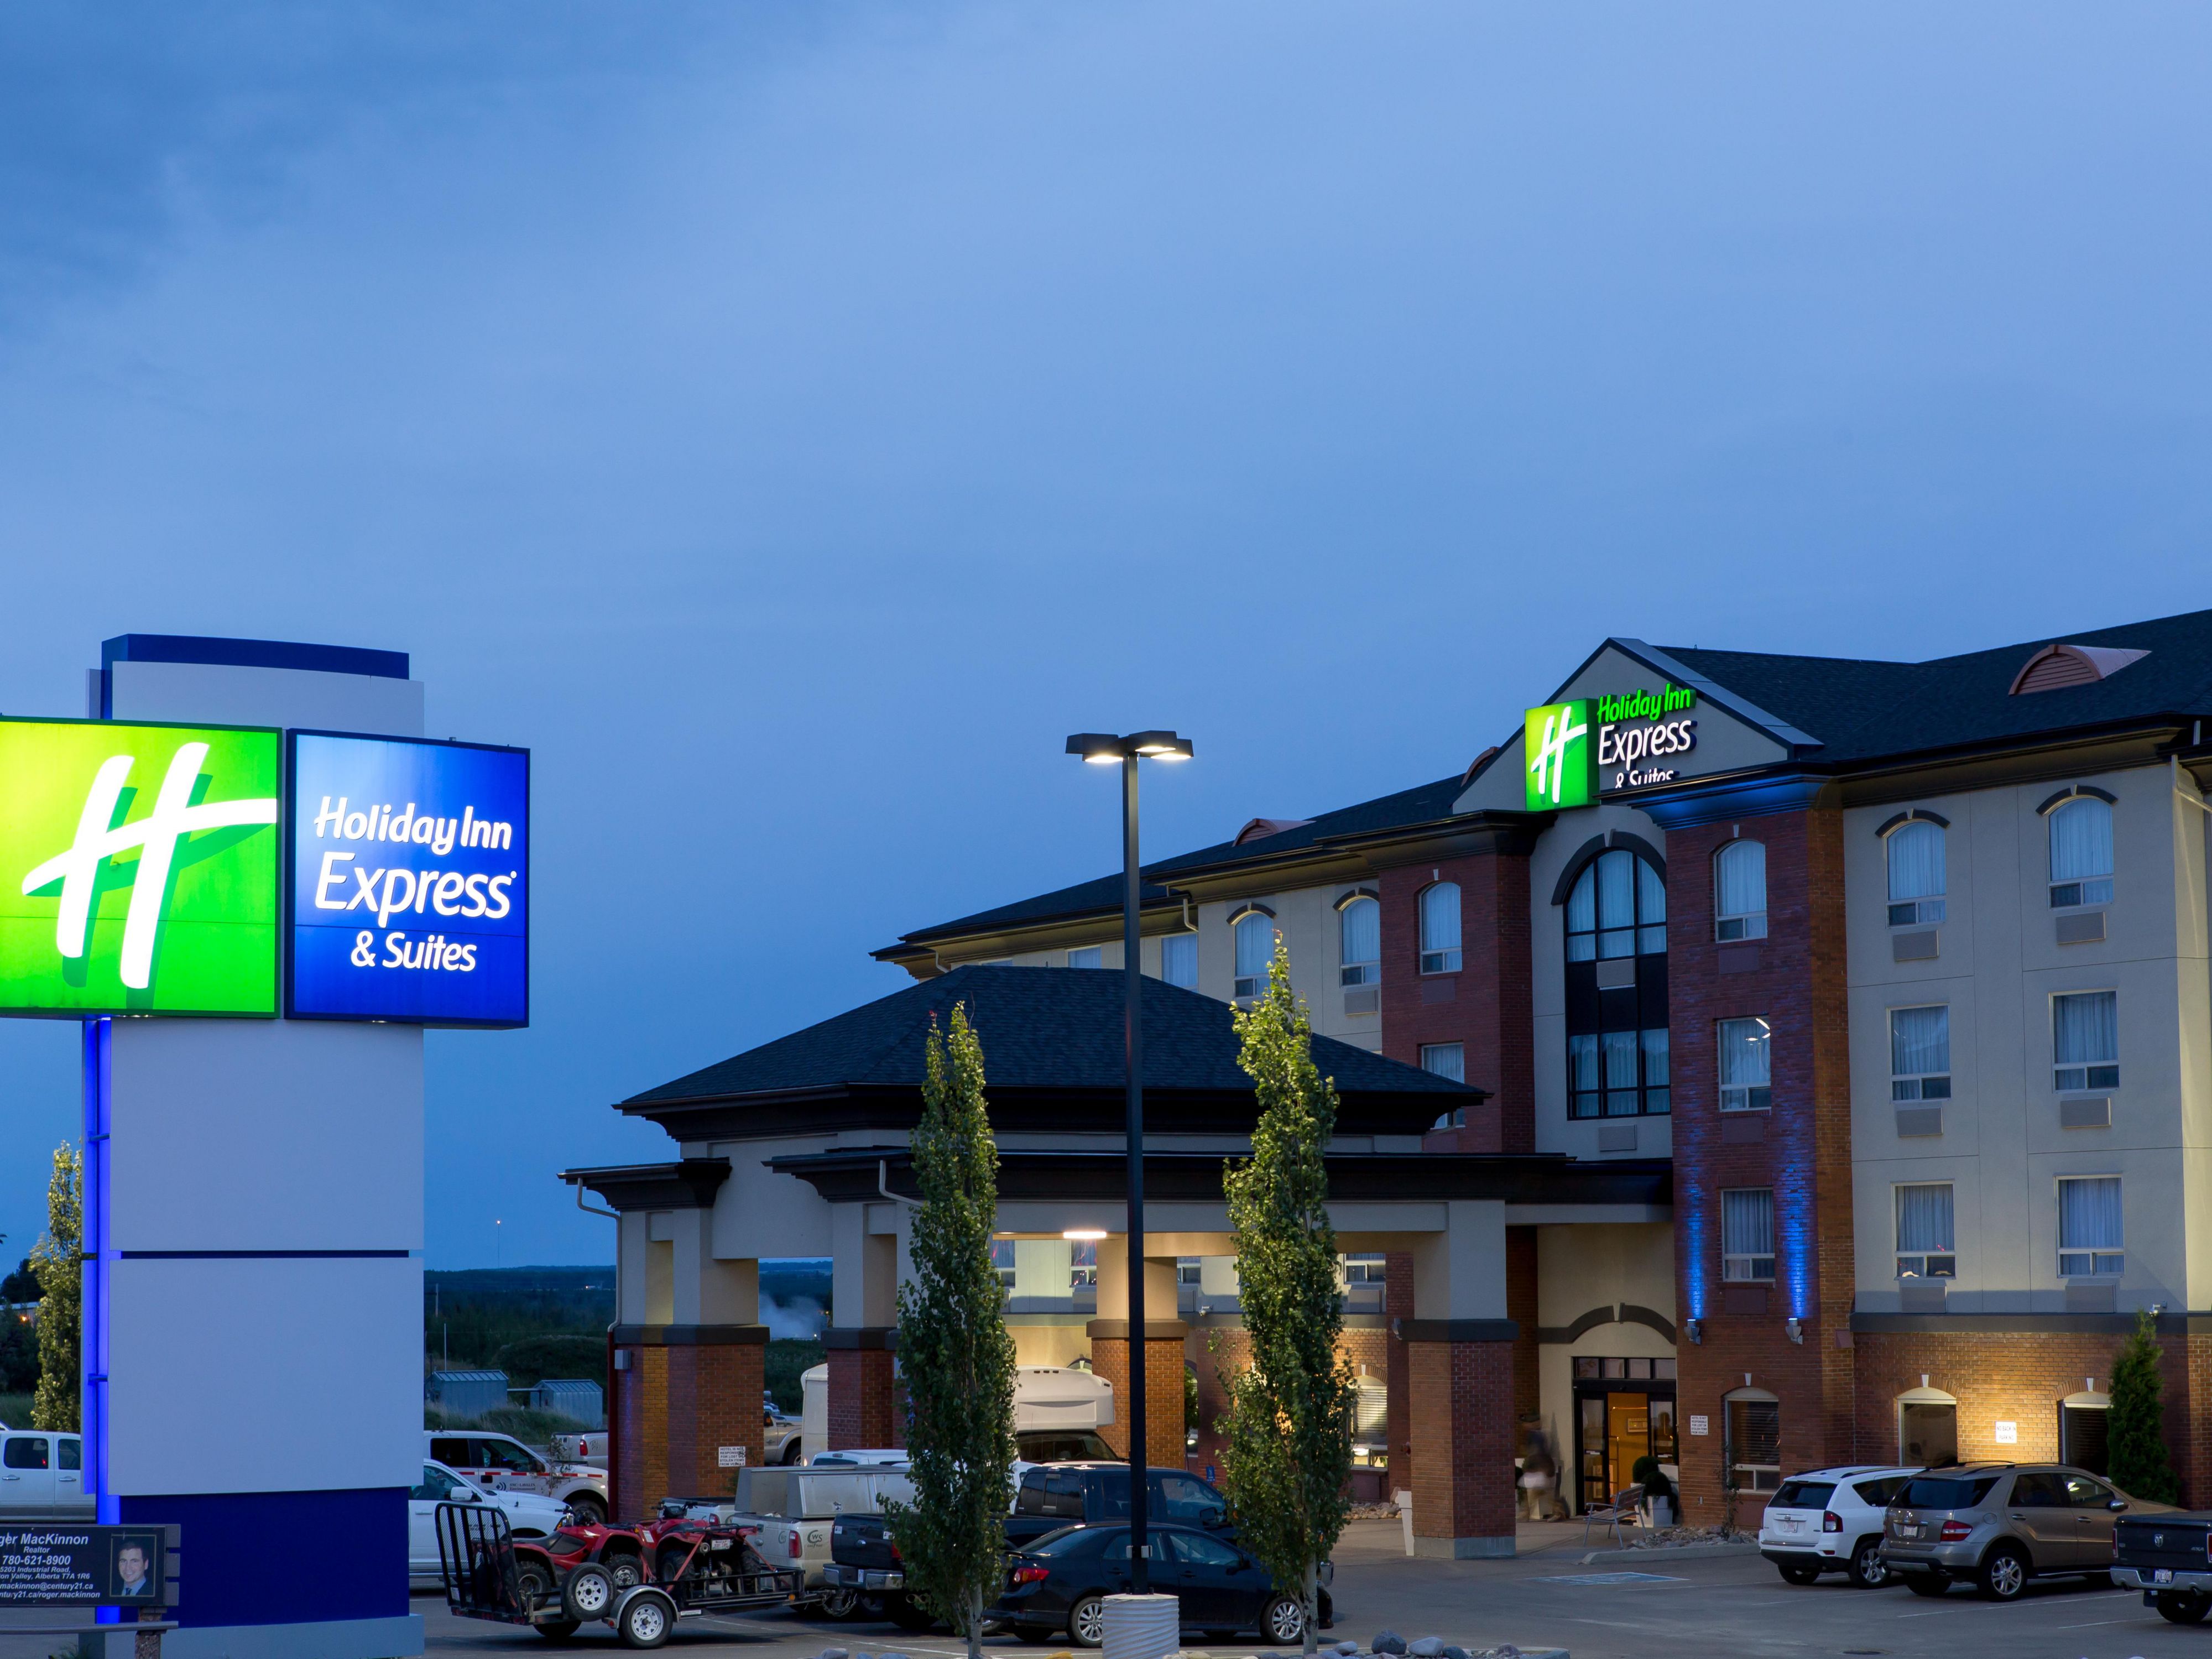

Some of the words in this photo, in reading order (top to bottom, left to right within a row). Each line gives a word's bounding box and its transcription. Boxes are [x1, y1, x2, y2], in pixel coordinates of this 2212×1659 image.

[1597, 689, 1662, 723] Holiday
[1664, 683, 1691, 712] Inn
[1598, 720, 1692, 770] Express
[314, 796, 457, 855] Holiday
[460, 805, 512, 850] Inn
[315, 851, 513, 928] Express
[350, 931, 376, 967] &
[382, 932, 477, 972] Suites
[20, 1533, 88, 1545] MacKinnon
[3, 1555, 71, 1565] 780-621-8900
